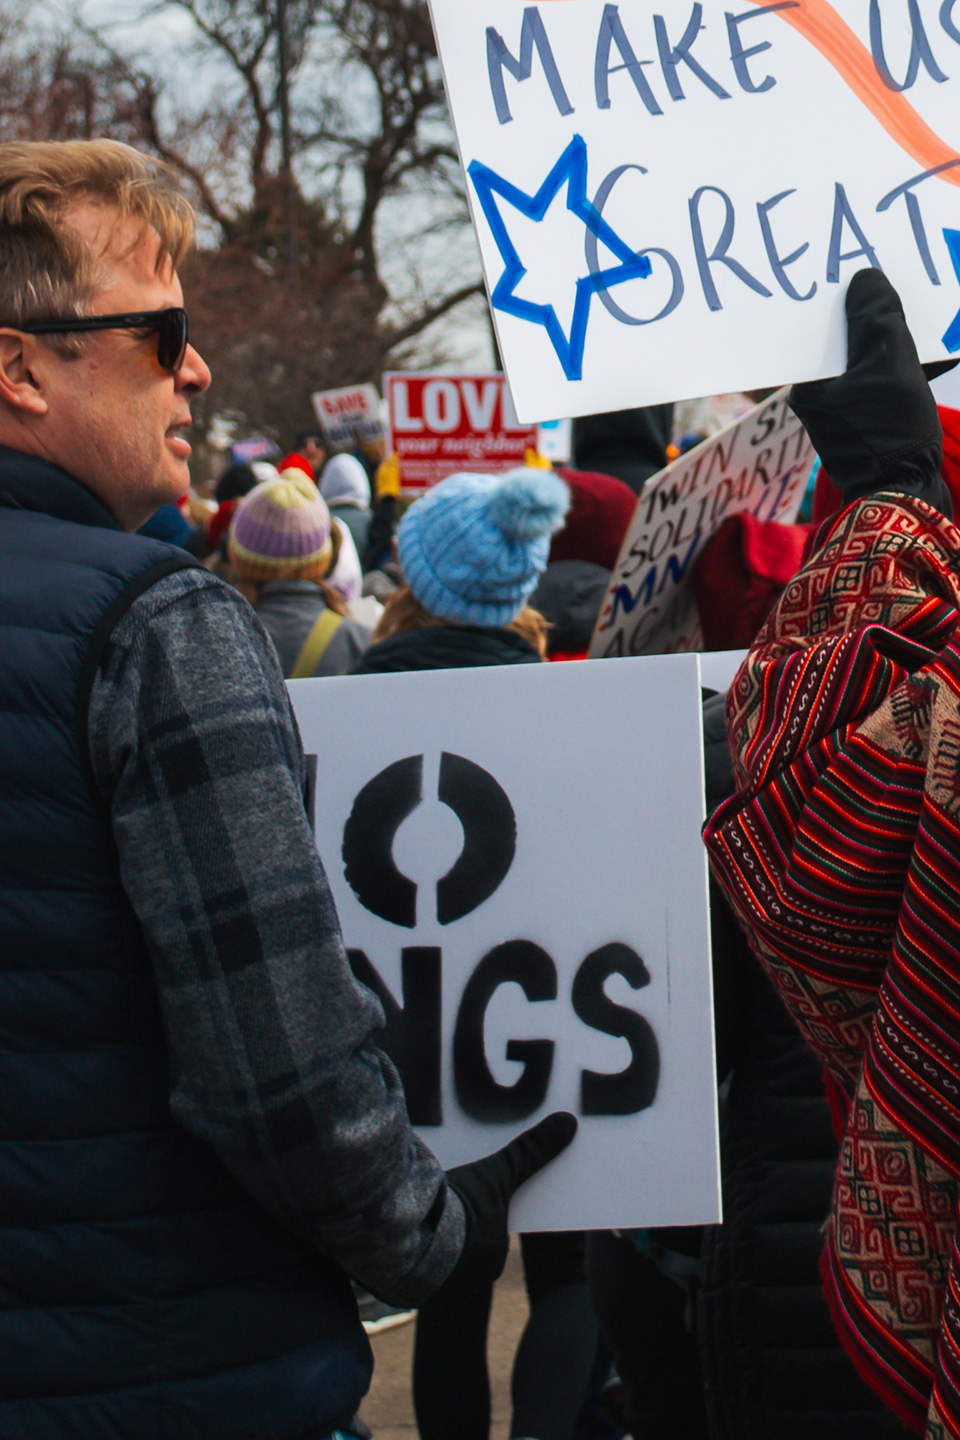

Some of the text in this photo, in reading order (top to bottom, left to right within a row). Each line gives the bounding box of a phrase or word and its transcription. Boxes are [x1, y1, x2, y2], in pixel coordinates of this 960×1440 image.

[485, 0, 800, 125] MAKE
[645, 422, 741, 524] TWIN
[303, 751, 517, 928] O
